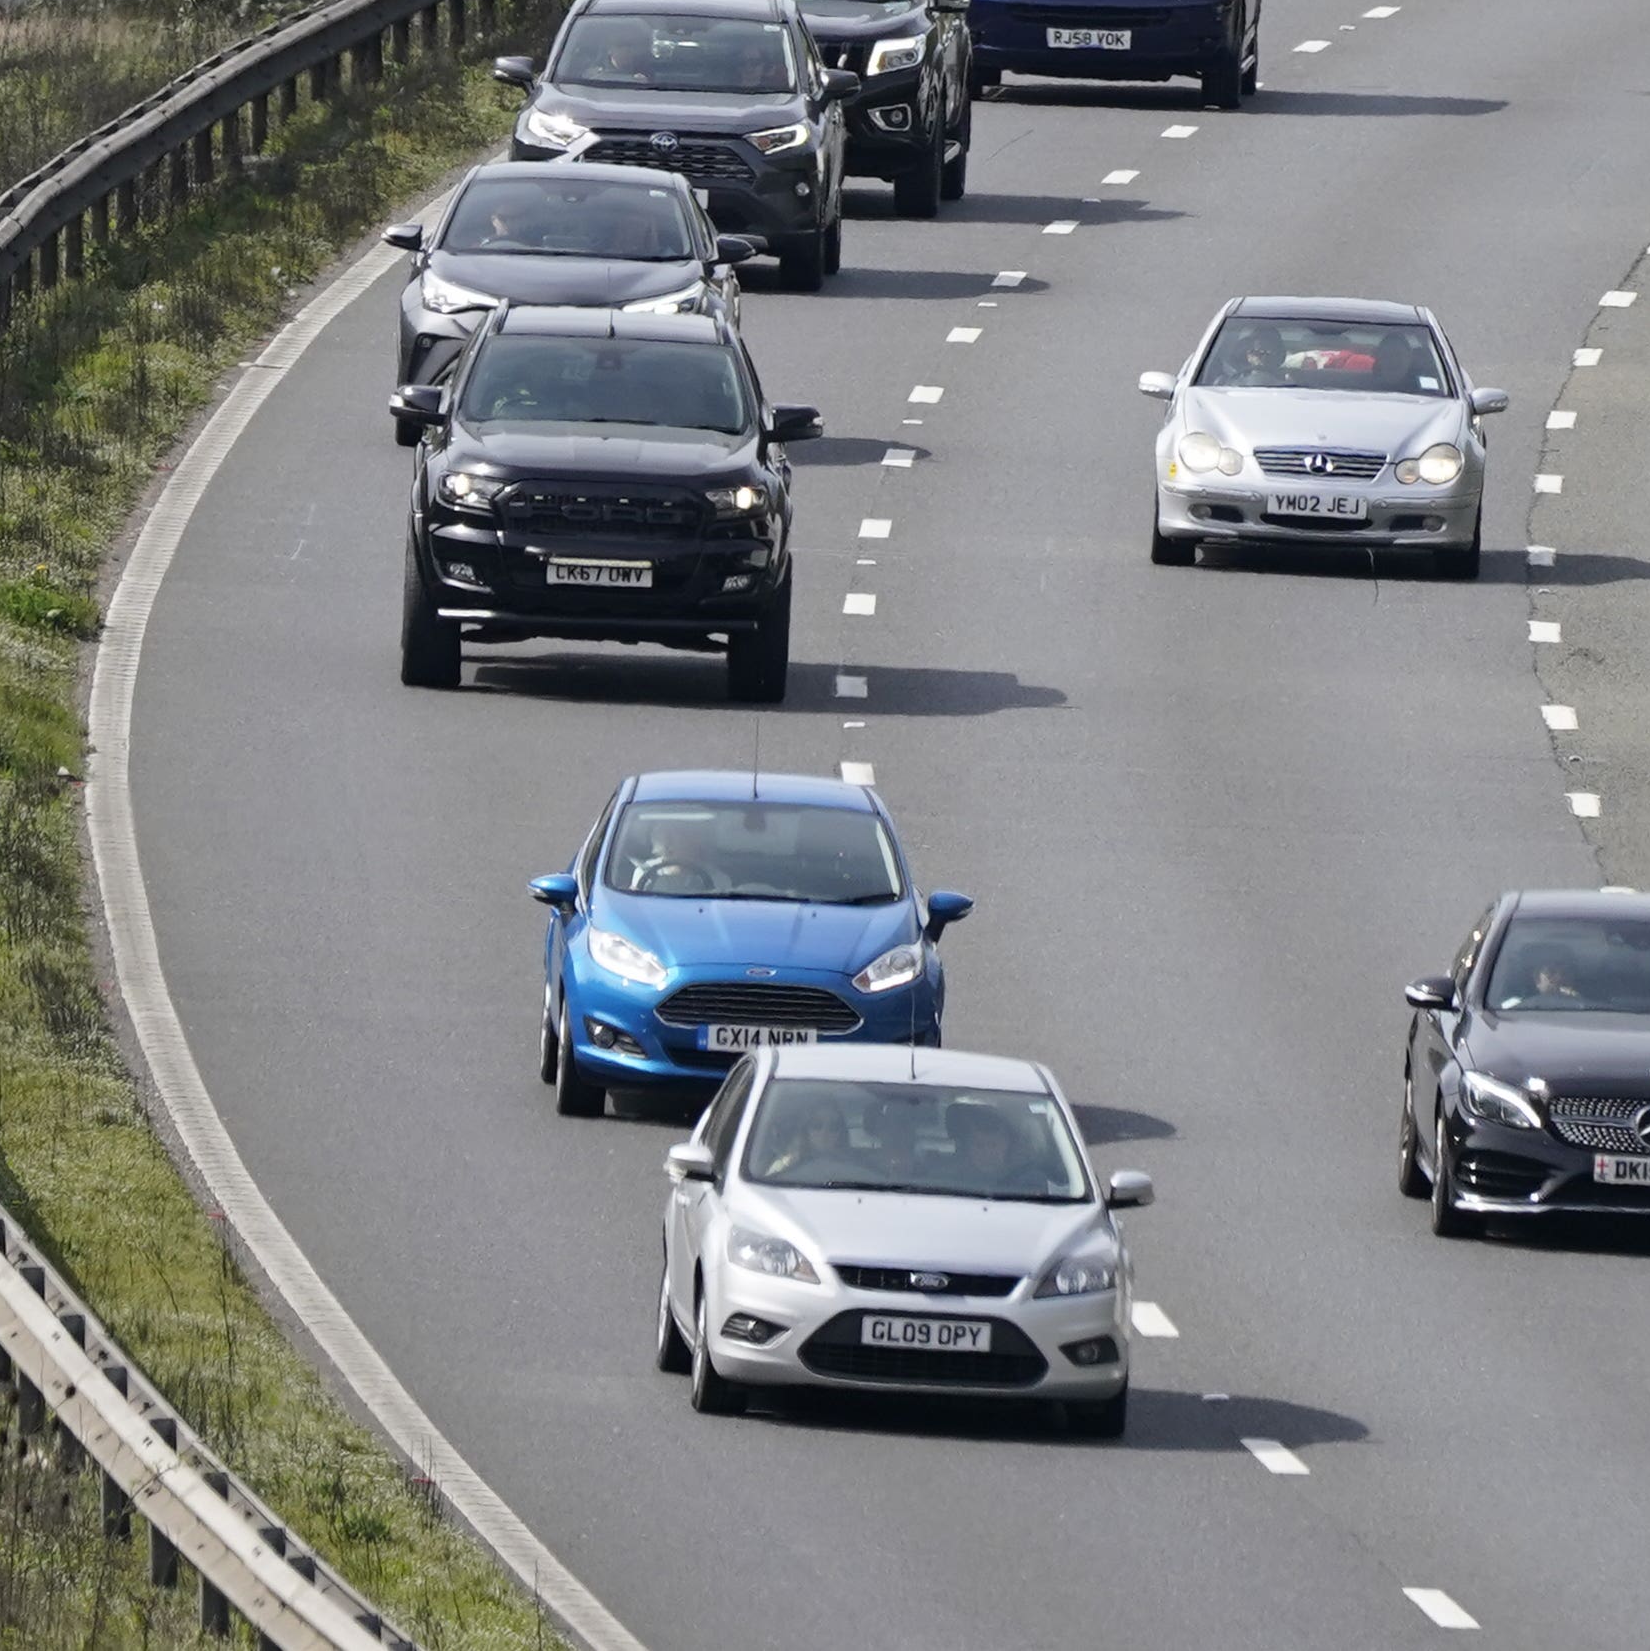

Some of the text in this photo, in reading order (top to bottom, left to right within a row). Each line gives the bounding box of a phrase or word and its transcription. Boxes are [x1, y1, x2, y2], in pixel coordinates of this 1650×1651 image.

[1053, 30, 1092, 46] RJ58
[1326, 497, 1359, 515] JEJ
[715, 1027, 761, 1049] GX14
[871, 1320, 931, 1345] GL09
